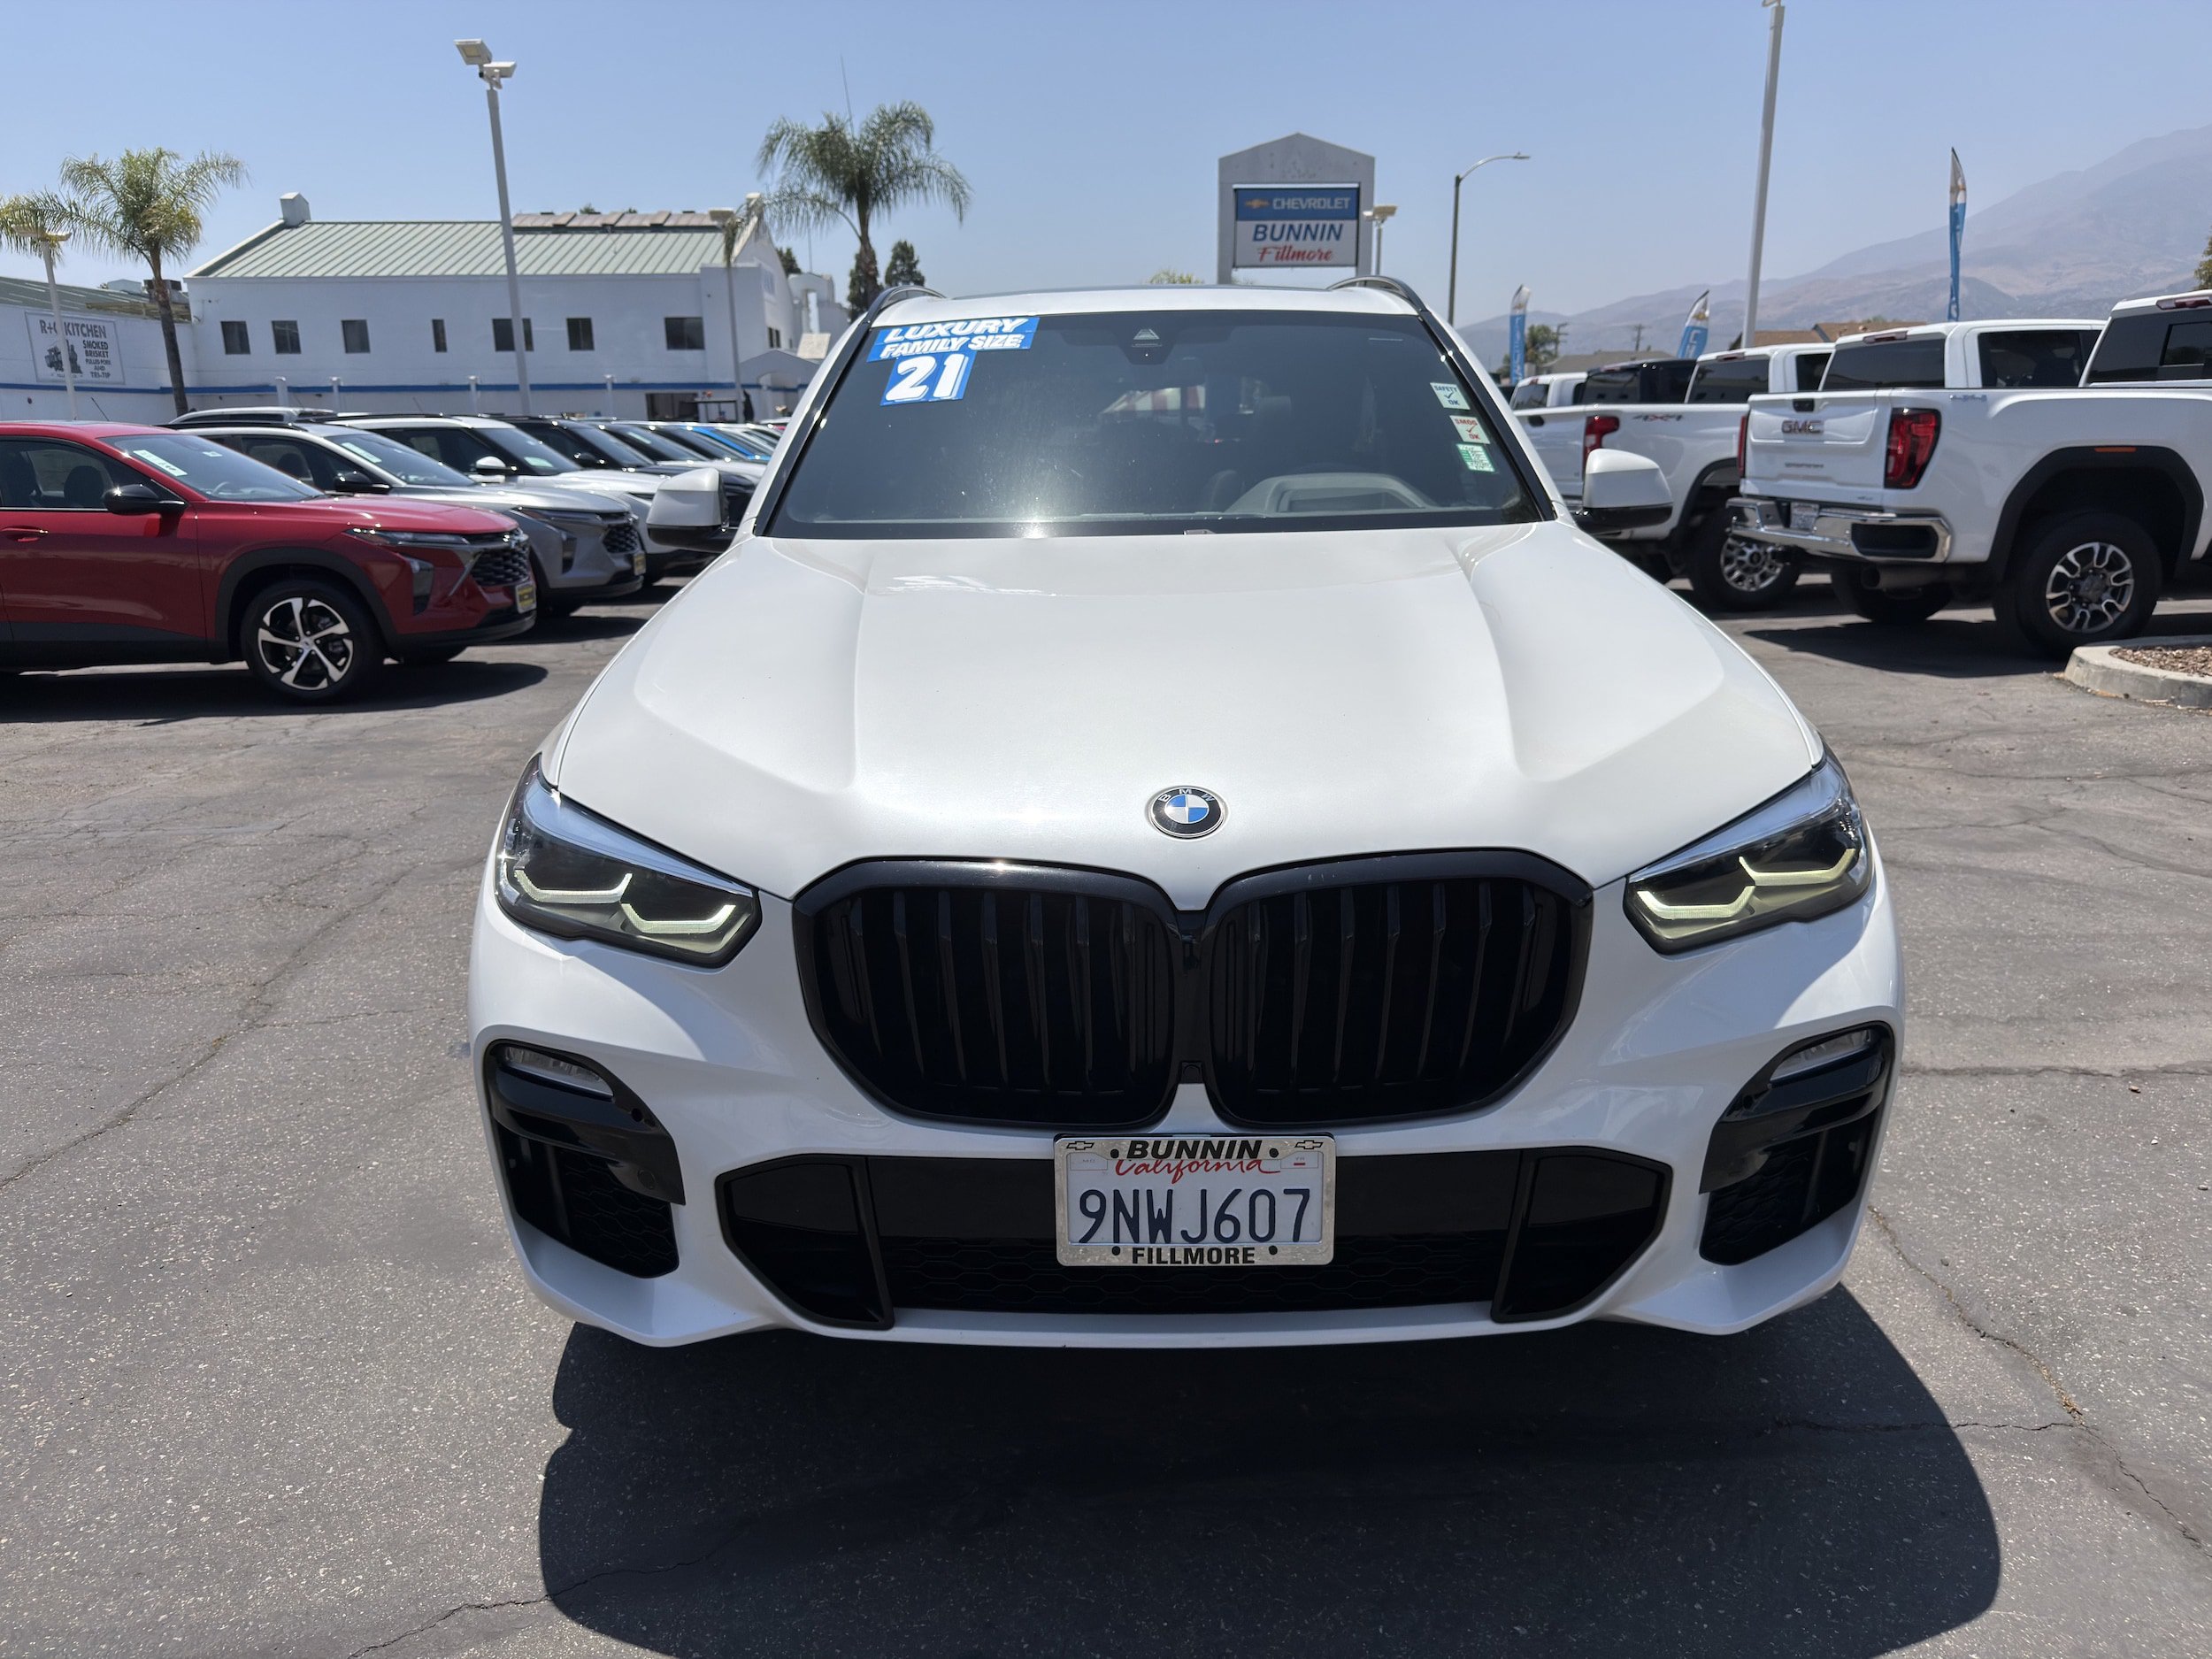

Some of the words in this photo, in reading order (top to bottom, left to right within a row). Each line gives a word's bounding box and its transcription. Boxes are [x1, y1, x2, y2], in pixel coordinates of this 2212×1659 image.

[1272, 197, 1351, 210] CHEVROLET
[1252, 224, 1343, 242] BUNNIN
[1258, 244, 1333, 263] Fillmore
[64, 321, 107, 338] KITCHEN
[883, 318, 1029, 343] LUXURY
[82, 340, 109, 350] SMOKED
[84, 349, 109, 358] BRISKET
[879, 336, 971, 358] FAMILY
[968, 334, 1025, 350] SIZE
[886, 353, 969, 403] 21
[1781, 419, 1824, 434] GMC
[1158, 788, 1216, 803] BMW
[1126, 1140, 1263, 1160] BUNNIN
[1115, 1158, 1280, 1184] California
[1078, 1188, 1311, 1244] 9NWJ607
[1132, 1247, 1256, 1265] FILLMORE
